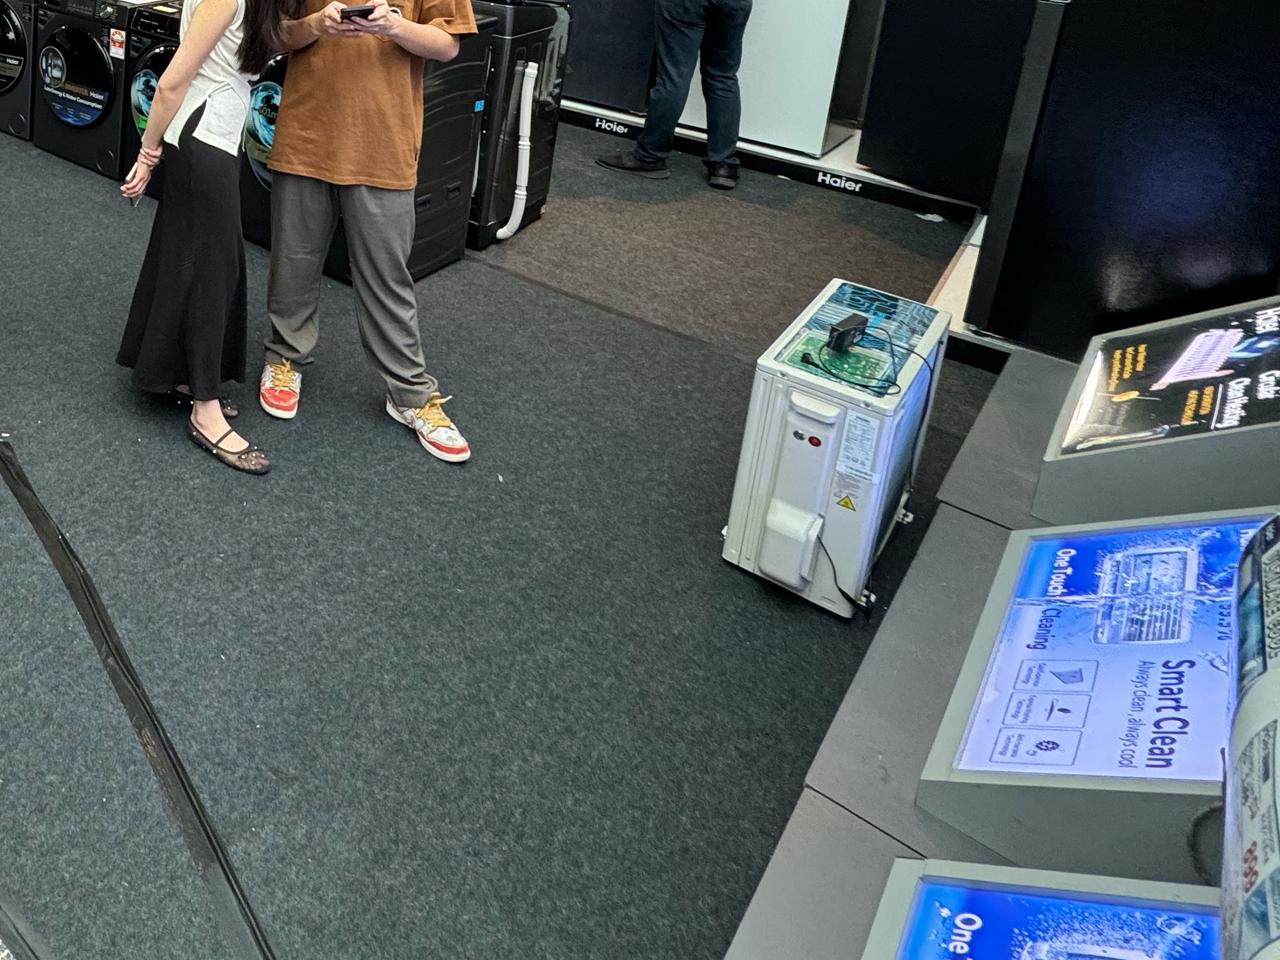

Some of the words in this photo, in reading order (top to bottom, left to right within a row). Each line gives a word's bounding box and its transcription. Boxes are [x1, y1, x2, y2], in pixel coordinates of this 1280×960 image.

[817, 172, 862, 193] Haier
[1053, 548, 1077, 567] One
[1045, 567, 1071, 597] Touch
[1027, 608, 1062, 650] Cleaning
[1132, 660, 1156, 689] Always
[1157, 659, 1196, 714] Smart
[1129, 690, 1151, 713] clean
[1145, 717, 1190, 769] Clean
[1118, 748, 1138, 769] cool
[948, 912, 983, 955] One
